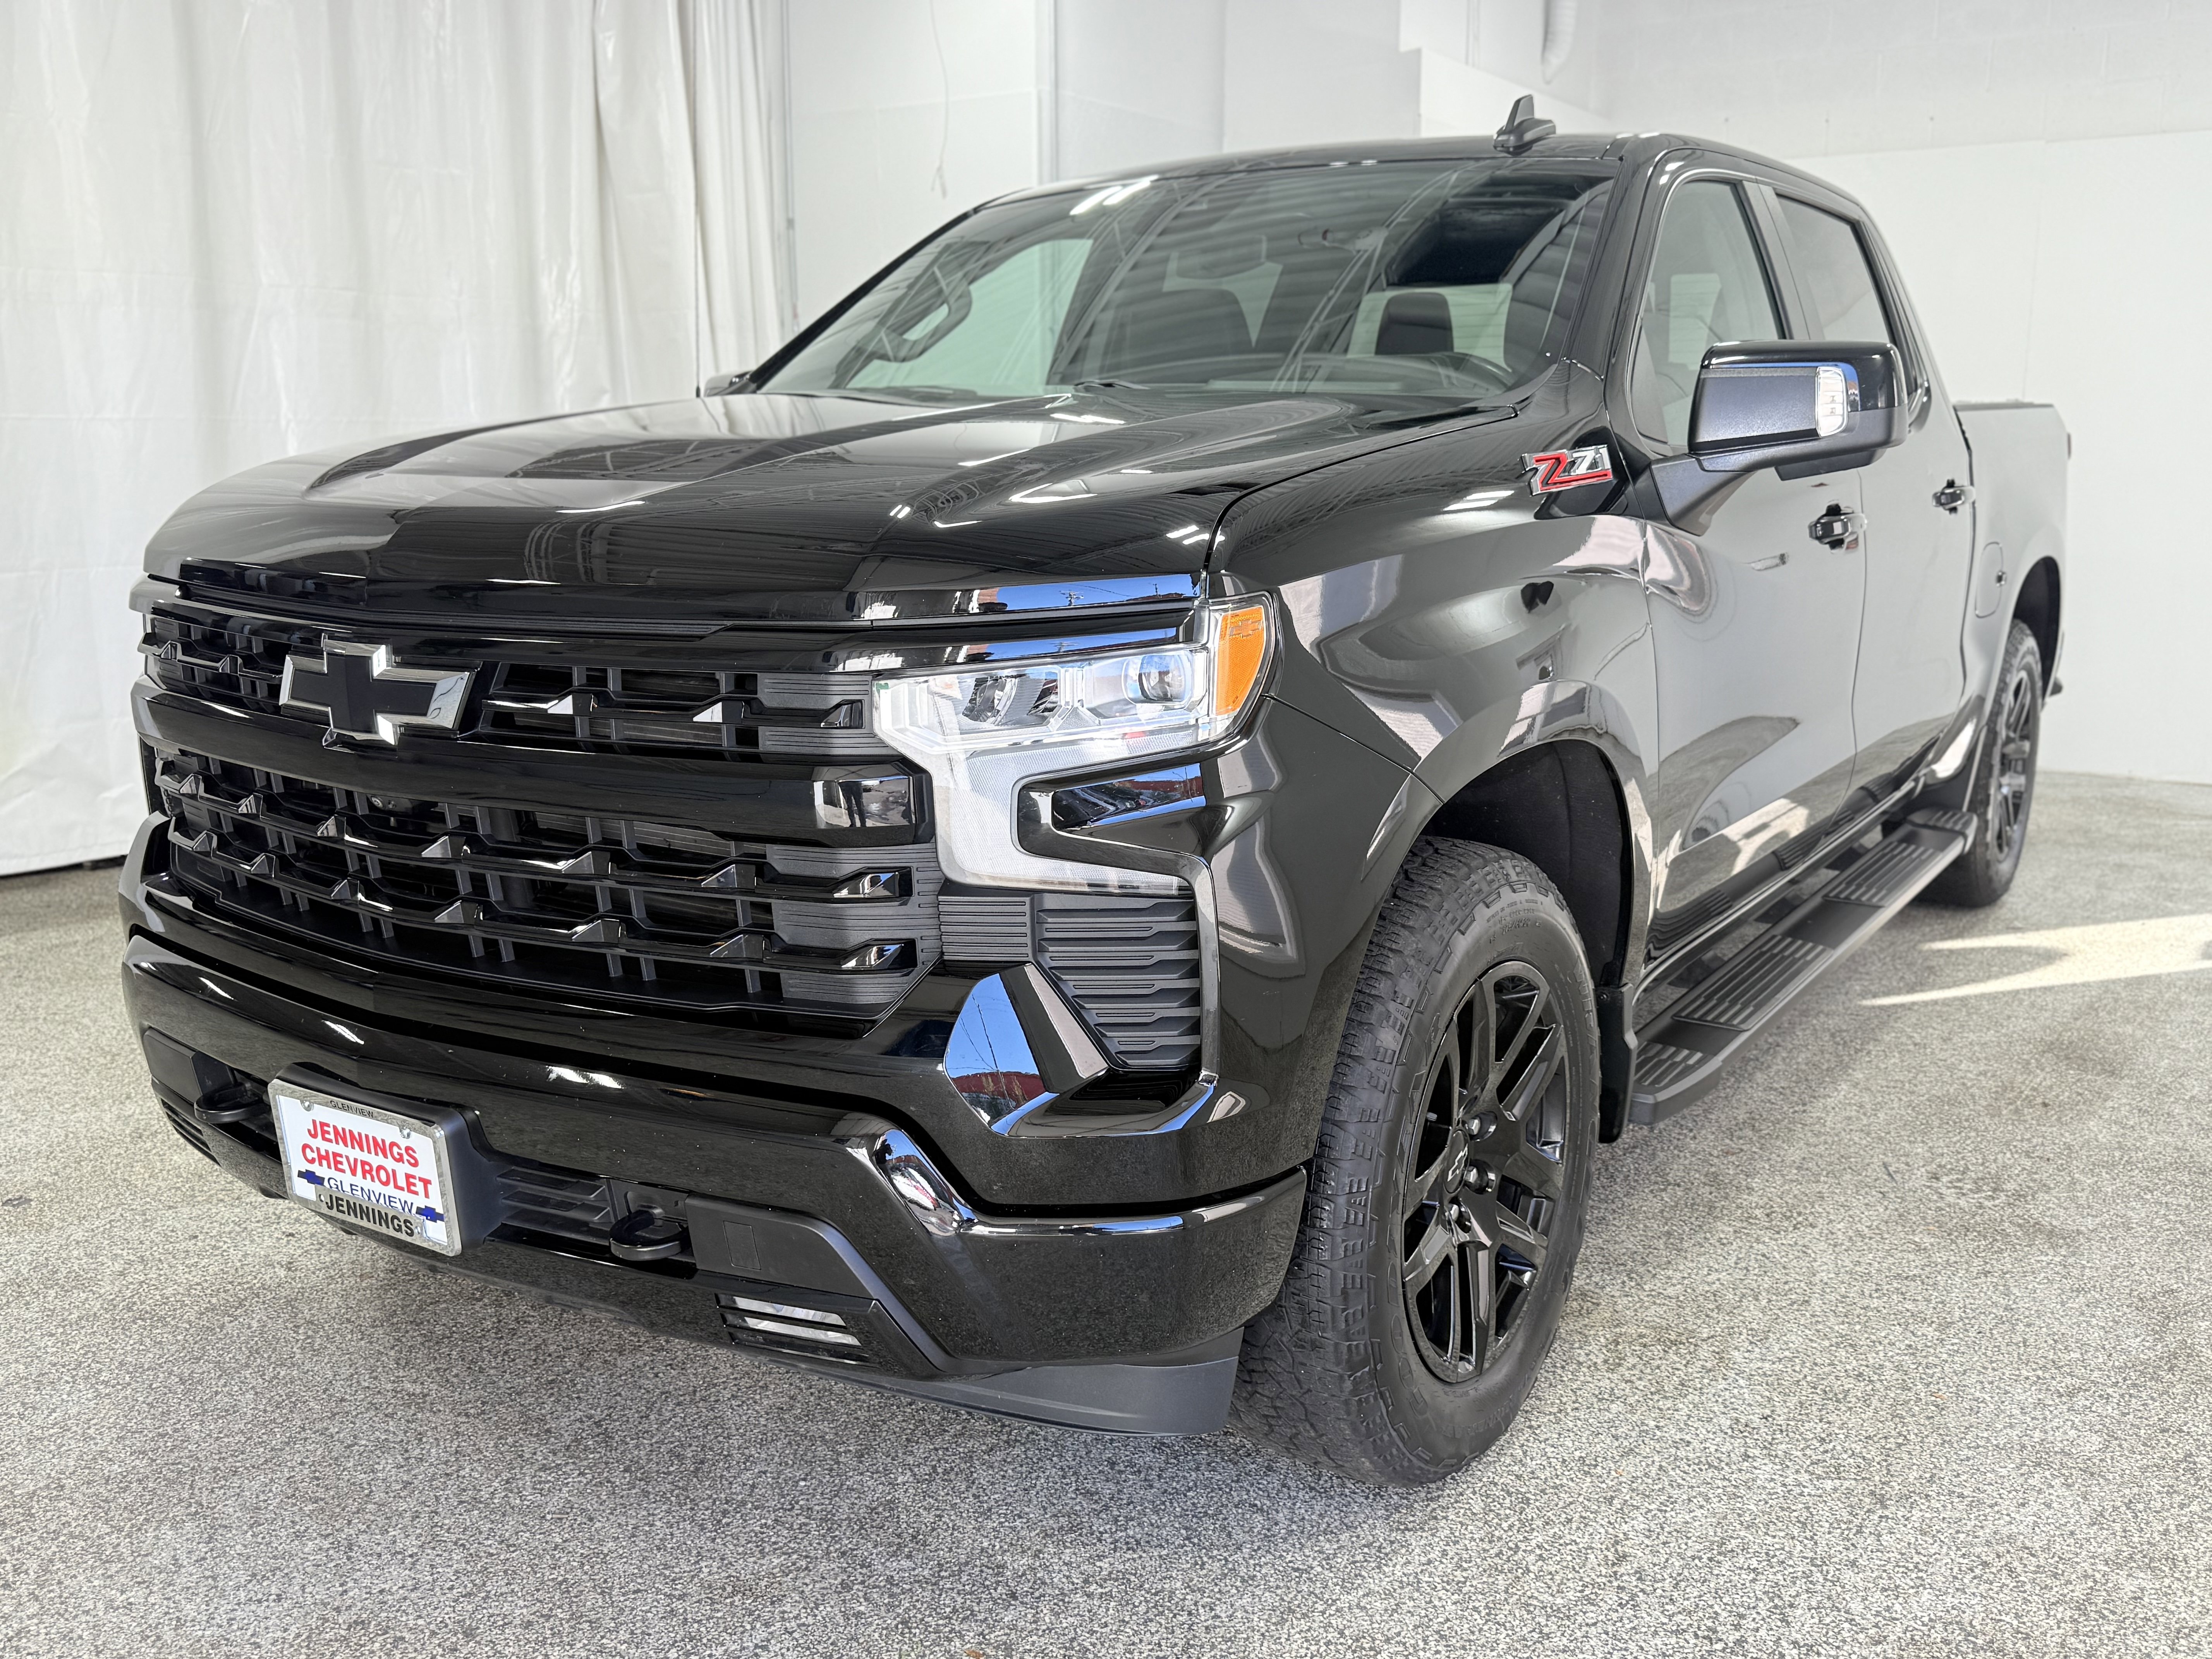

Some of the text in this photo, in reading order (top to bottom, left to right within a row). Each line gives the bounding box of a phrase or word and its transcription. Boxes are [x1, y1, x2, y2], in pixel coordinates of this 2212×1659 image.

[1524, 445, 1613, 496] Z71
[330, 1100, 374, 1118] GLENVIEW
[307, 1119, 419, 1168] JENNINGS
[301, 1143, 432, 1199] CHEVROLET
[325, 1194, 414, 1237] JENNINGS
[328, 1177, 414, 1215] GLENVIEW
[1387, 1012, 1441, 1419] GOODYEAR
